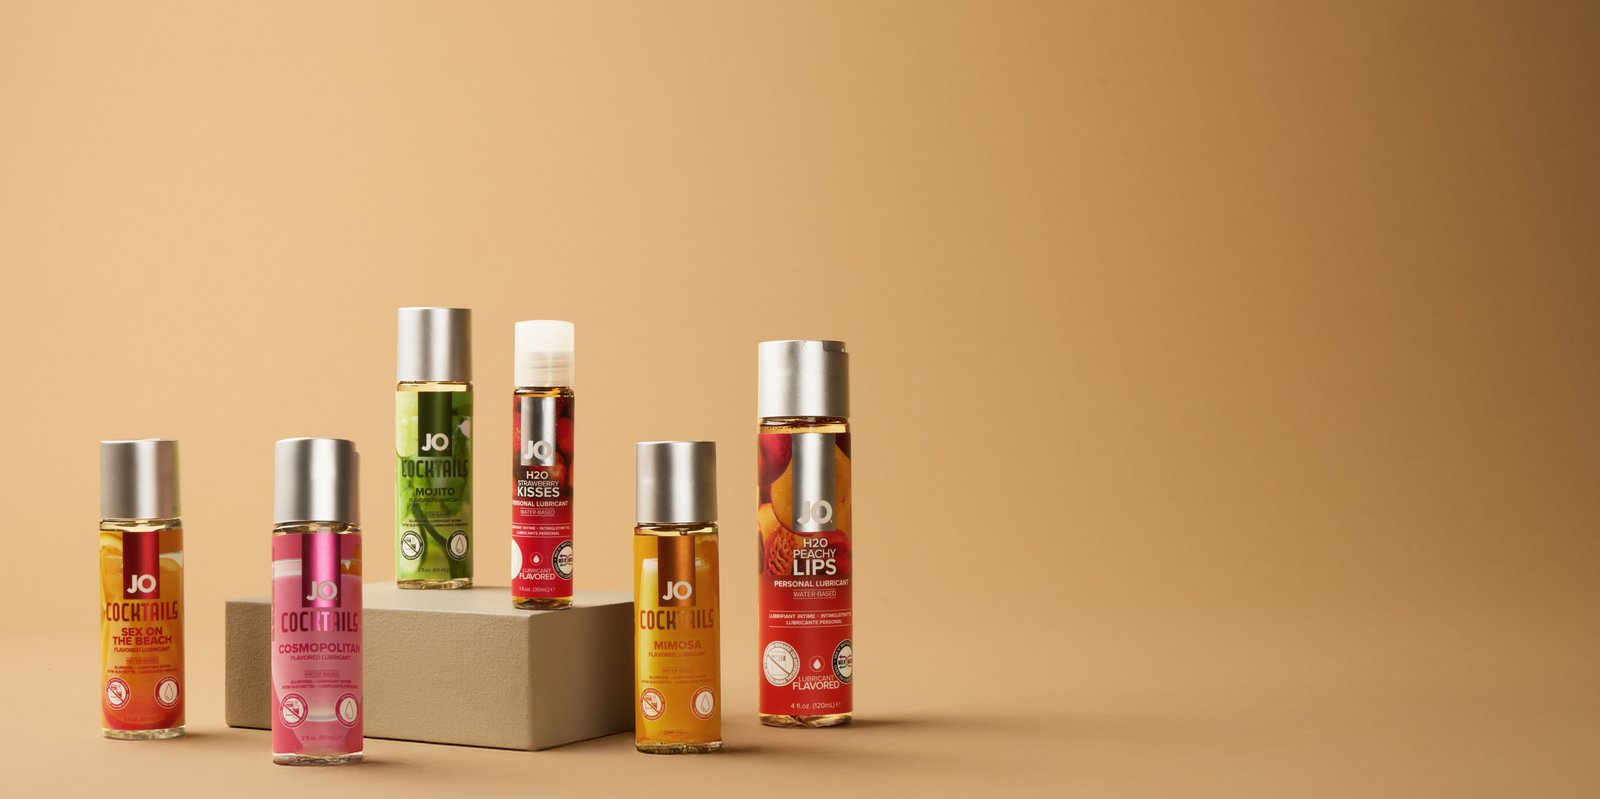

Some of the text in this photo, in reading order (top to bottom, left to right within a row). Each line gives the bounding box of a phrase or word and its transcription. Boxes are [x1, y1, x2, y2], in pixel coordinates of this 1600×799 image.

[421, 433, 449, 451] JO
[523, 440, 553, 460] JO
[401, 459, 468, 478] COCKTAILS
[526, 471, 549, 480] H2O
[415, 487, 455, 496] MOJITO
[517, 487, 560, 497] KISSES
[803, 538, 828, 548] H2O
[793, 549, 836, 559] PEACHY
[793, 559, 837, 576] LIPS
[127, 574, 157, 593] JO
[774, 579, 849, 588] PERSONAL LUBRICANT
[306, 580, 338, 601] JO
[662, 581, 693, 601] JO
[106, 601, 178, 622] COCKTAILS
[281, 611, 358, 633] COCKTAILS
[640, 608, 714, 630] COCKAILS
[121, 627, 163, 636] SEX ON
[113, 635, 172, 645] THE BEACH
[654, 640, 702, 650] MIMOSA
[278, 643, 360, 654] COSMOPOLITAN
[792, 681, 840, 690] FLAVORED
